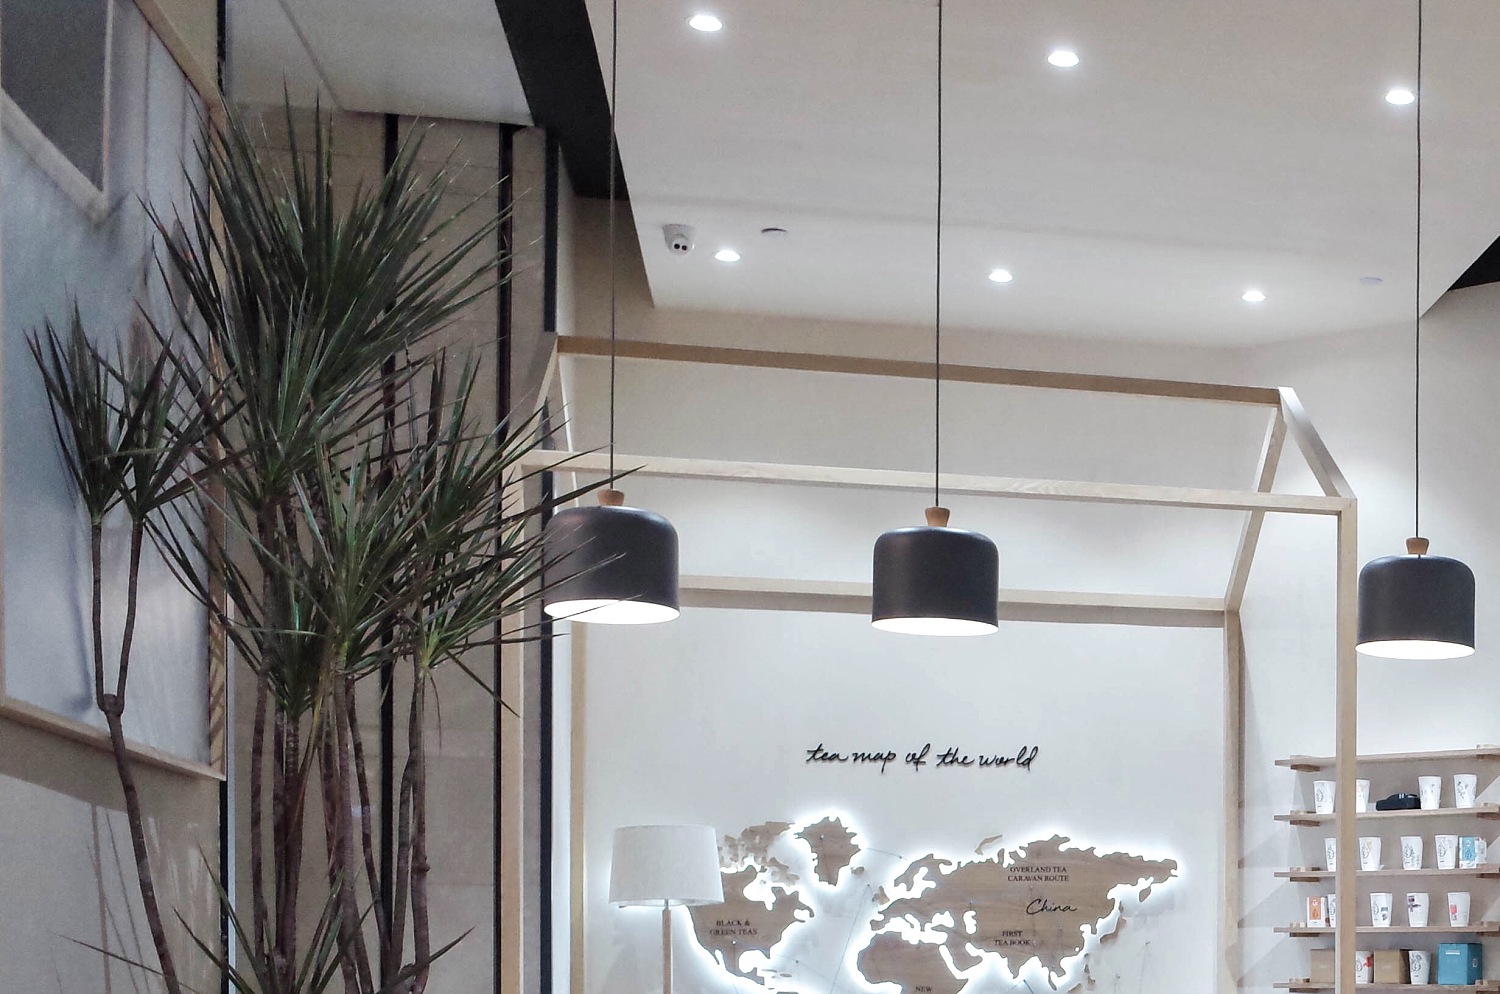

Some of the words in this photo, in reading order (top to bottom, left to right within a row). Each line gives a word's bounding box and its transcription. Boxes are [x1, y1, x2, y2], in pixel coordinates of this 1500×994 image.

[805, 743, 849, 763] tea
[851, 750, 897, 773] map
[905, 743, 932, 772] of
[936, 747, 975, 768] the
[978, 746, 1039, 771] world
[1025, 898, 1078, 915] China
[716, 919, 742, 927] BLACK
